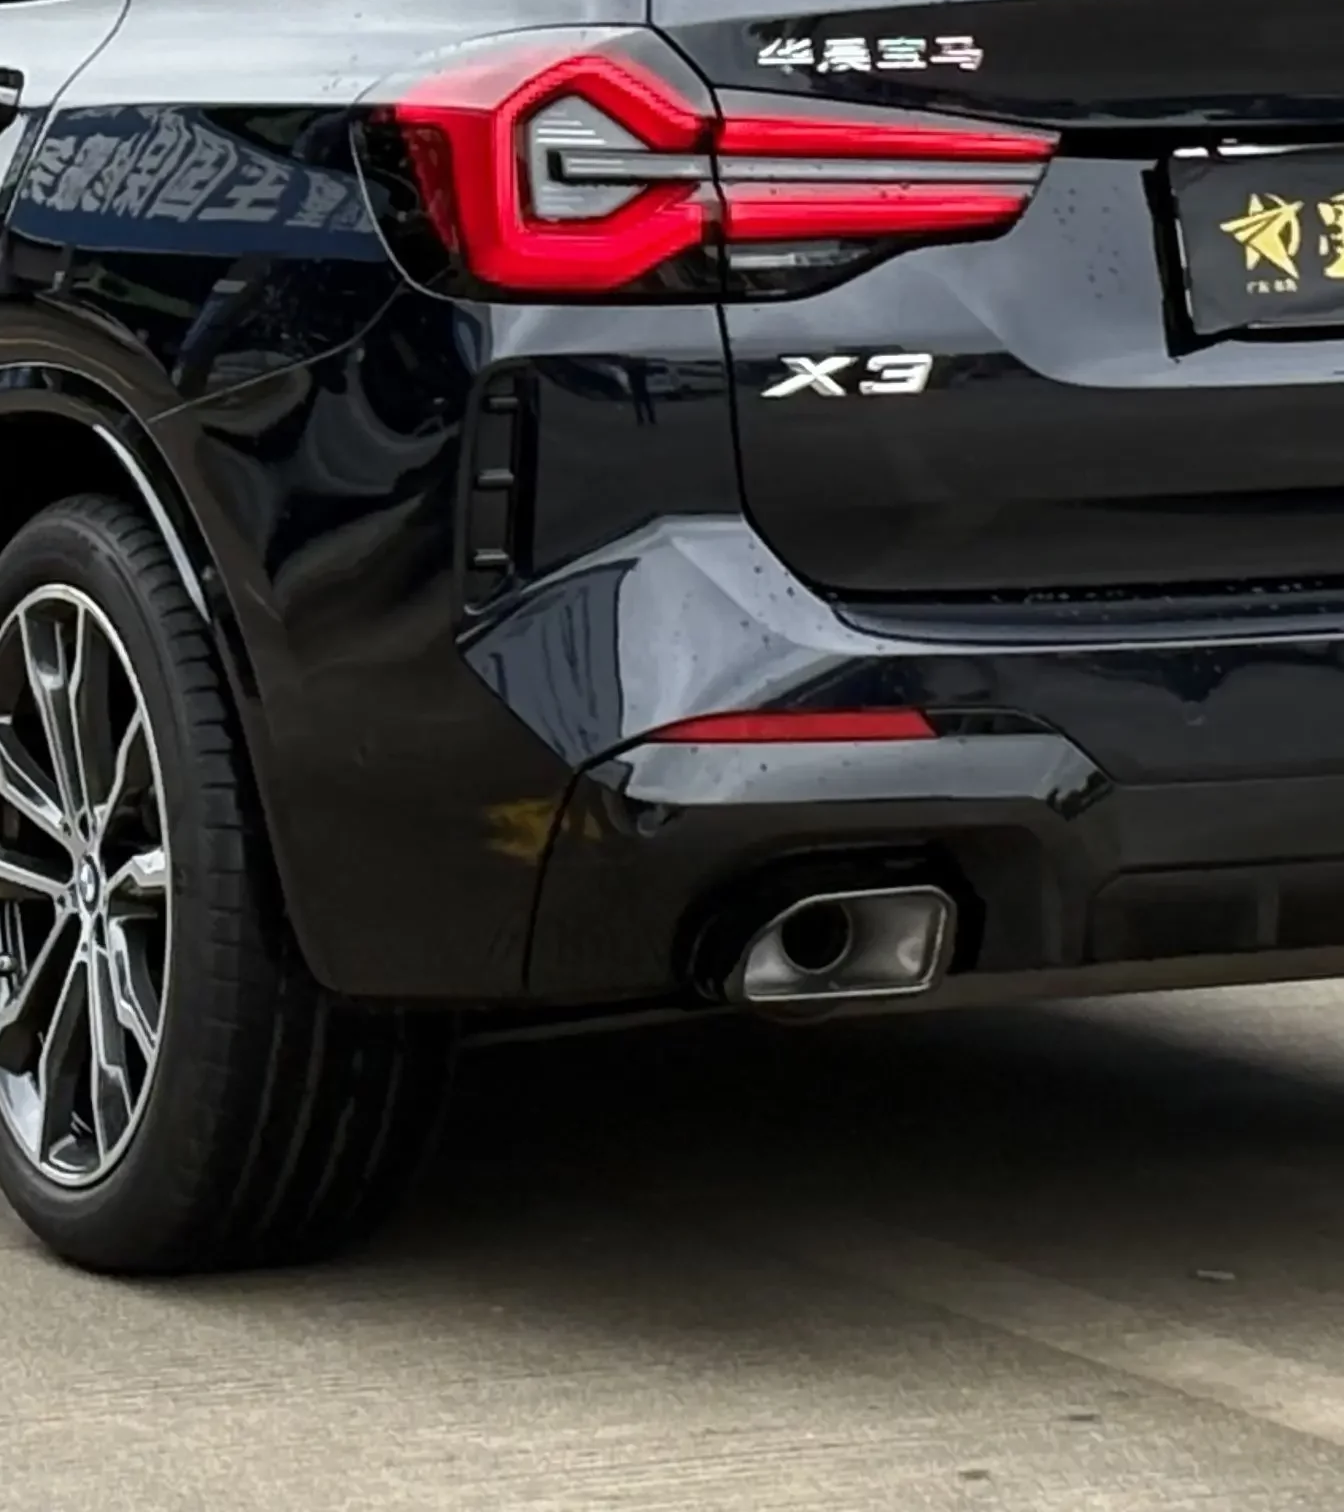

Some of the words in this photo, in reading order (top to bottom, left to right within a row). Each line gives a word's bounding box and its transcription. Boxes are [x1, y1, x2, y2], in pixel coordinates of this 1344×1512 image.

[758, 36, 984, 74] 华晨宝马
[760, 352, 933, 397] X3
